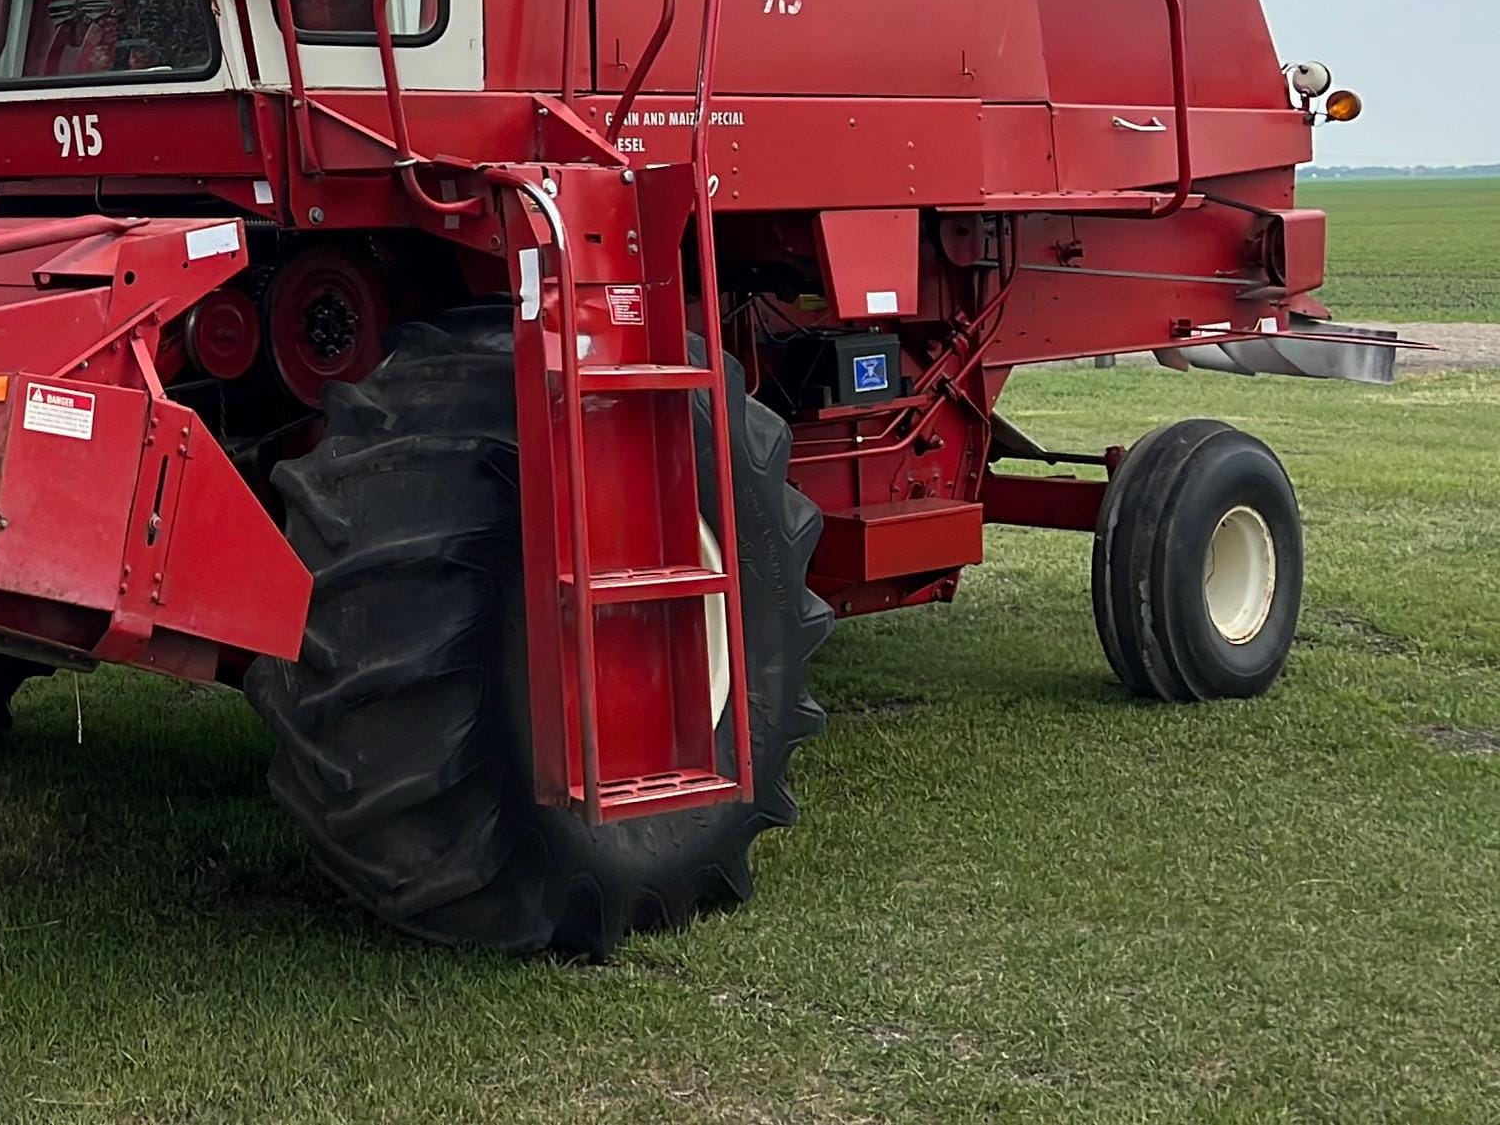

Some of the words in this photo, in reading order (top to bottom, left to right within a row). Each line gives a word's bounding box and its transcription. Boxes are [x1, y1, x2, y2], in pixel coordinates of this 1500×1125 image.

[605, 112, 639, 126] GAIN
[643, 112, 665, 125] AND
[668, 112, 702, 126] MAIZ
[708, 111, 745, 125] PECIAL
[53, 114, 103, 158] 915
[614, 137, 645, 152] ESEL
